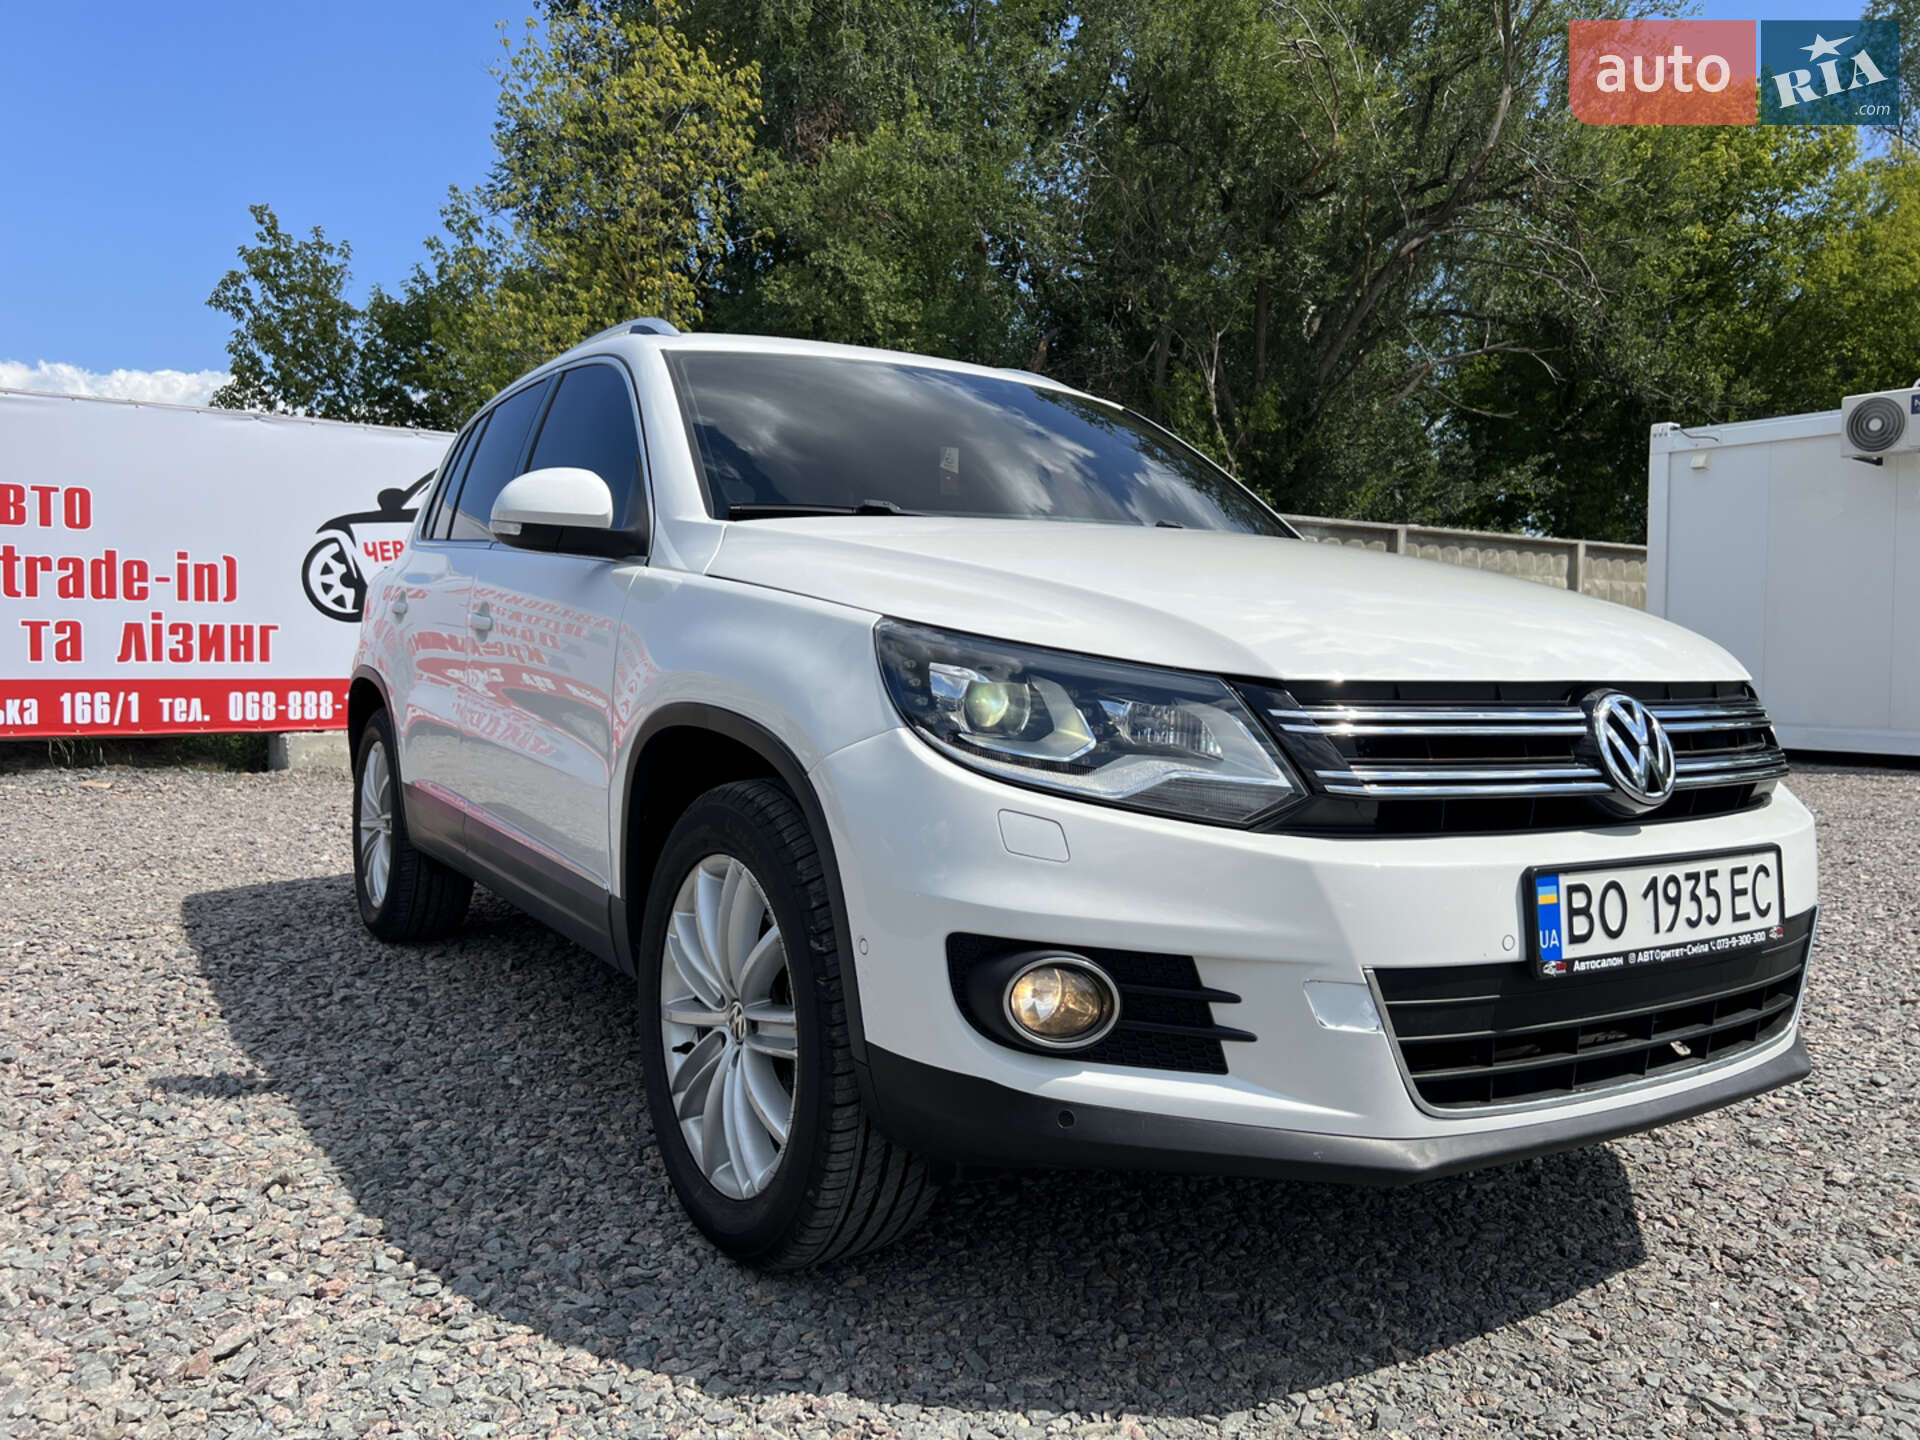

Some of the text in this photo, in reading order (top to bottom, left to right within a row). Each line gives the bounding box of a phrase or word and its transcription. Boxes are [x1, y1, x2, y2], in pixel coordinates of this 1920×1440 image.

[21, 612, 279, 663] та лізинг
[60, 691, 139, 726] 166/1
[160, 698, 210, 722] тел.
[229, 690, 349, 721] 068-888-
[1567, 864, 1772, 945] BO 1935 EC
[1539, 929, 1560, 948] UA
